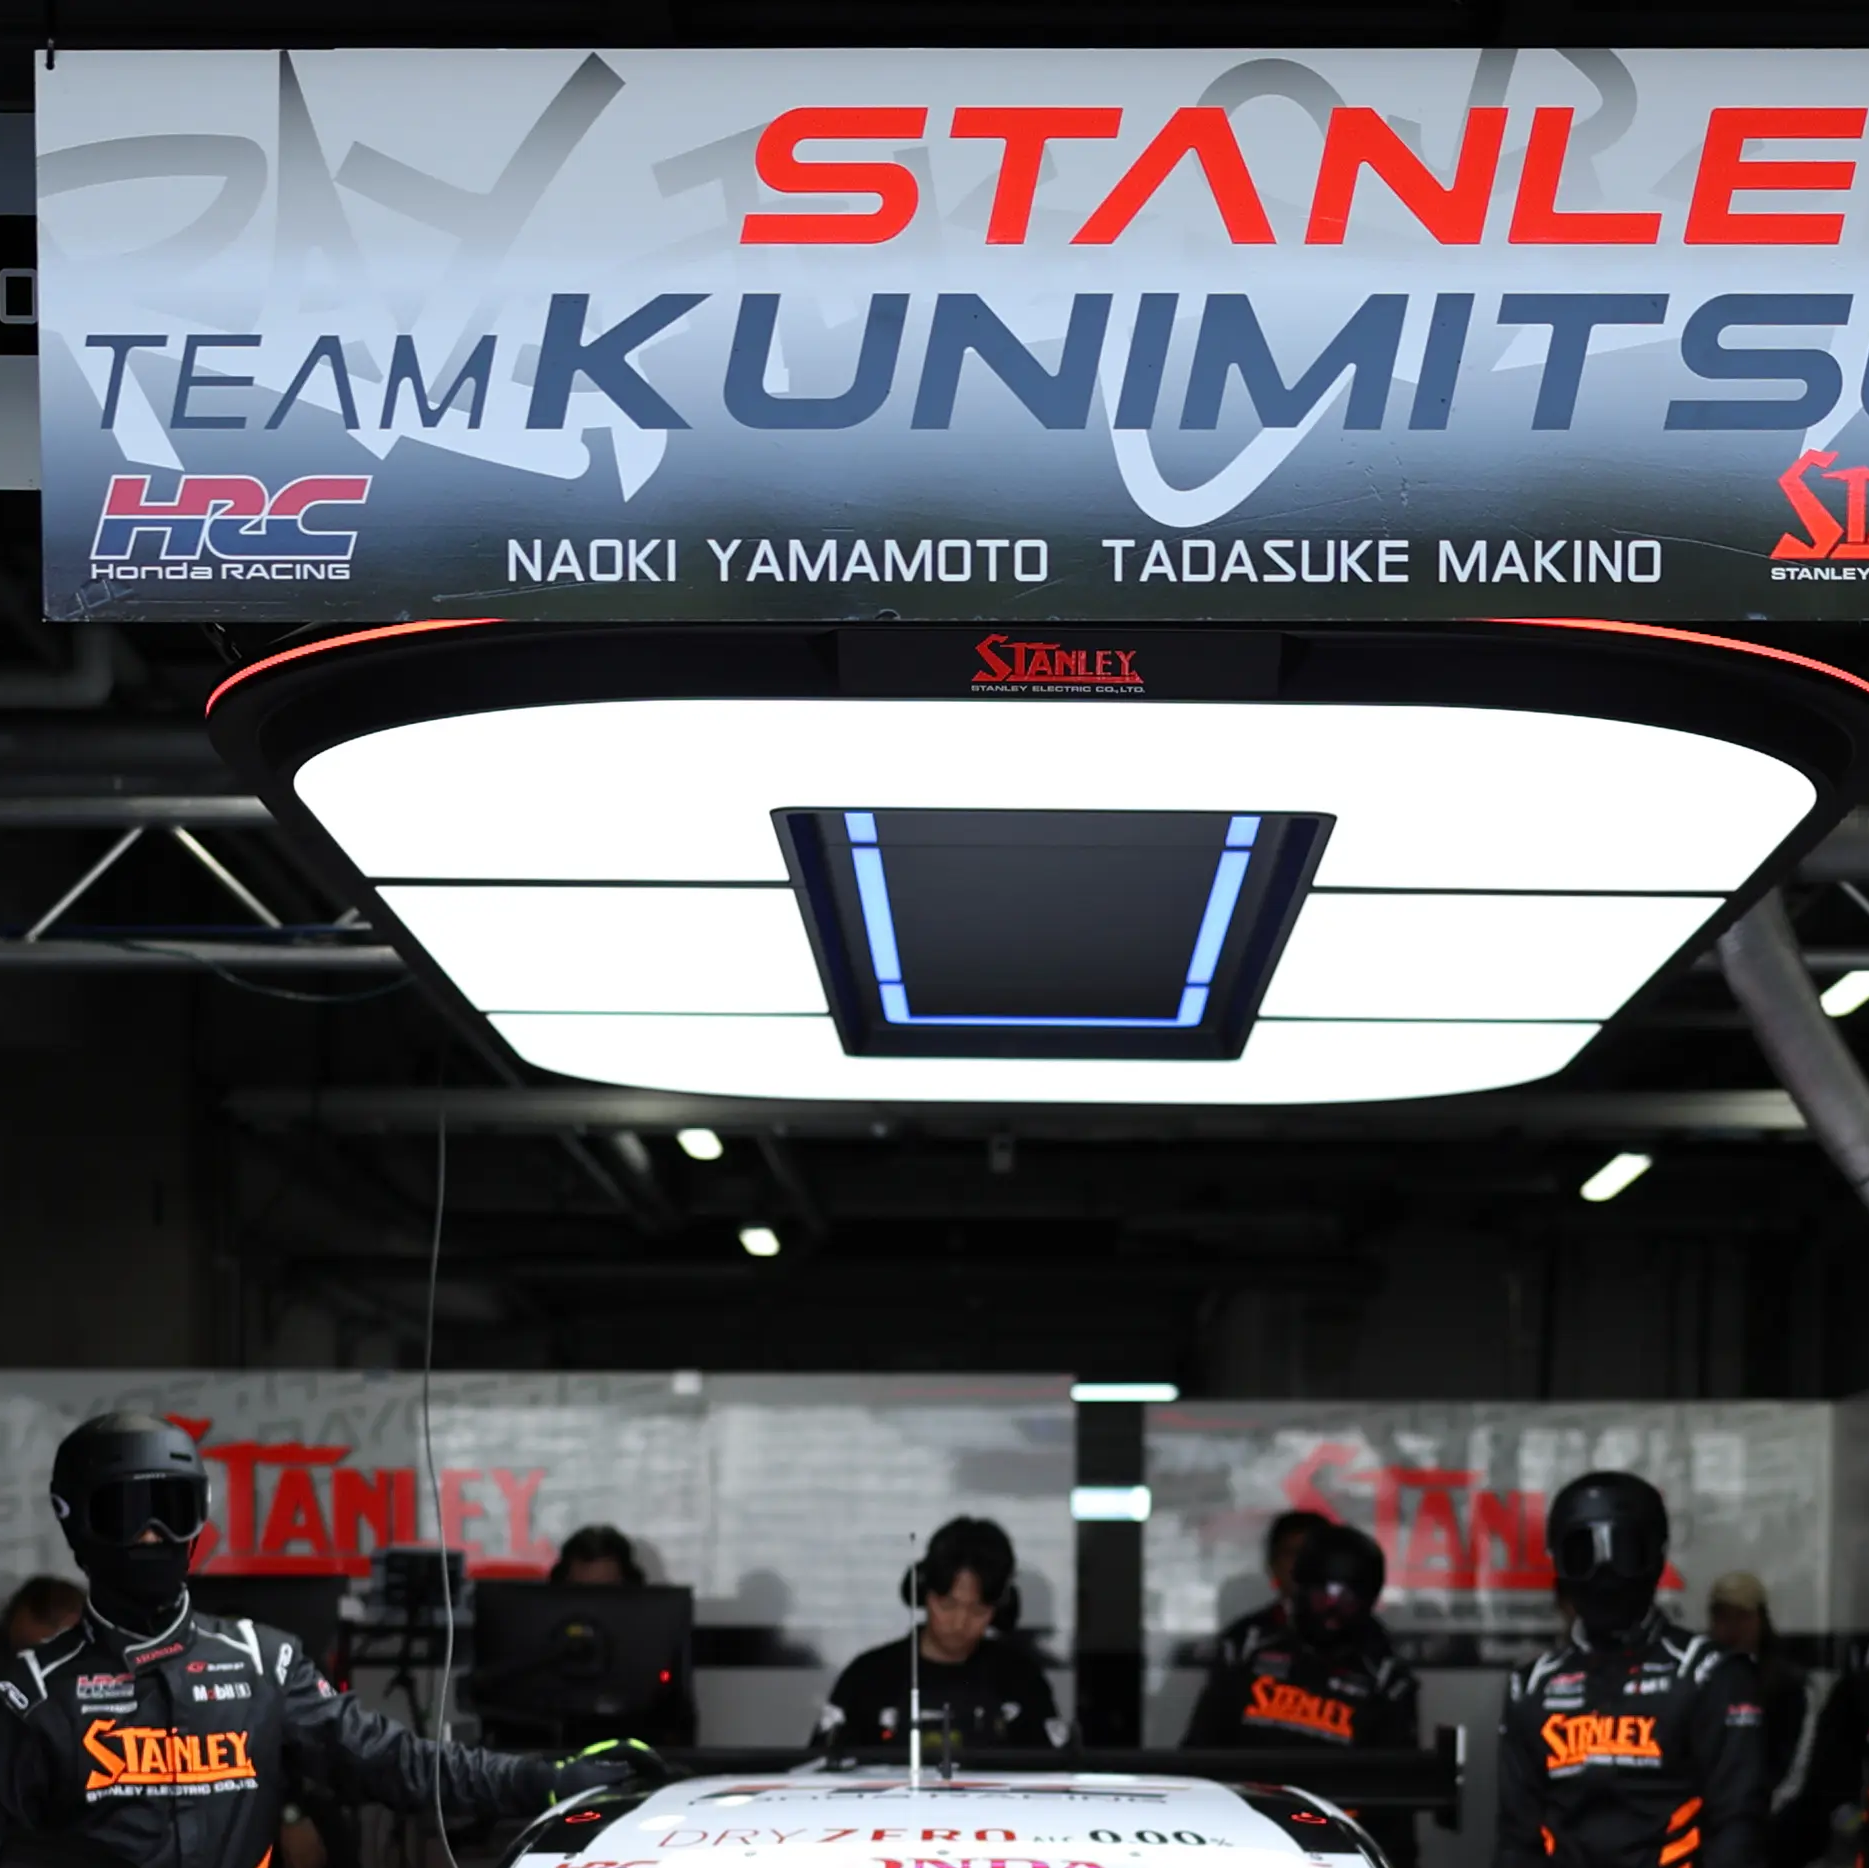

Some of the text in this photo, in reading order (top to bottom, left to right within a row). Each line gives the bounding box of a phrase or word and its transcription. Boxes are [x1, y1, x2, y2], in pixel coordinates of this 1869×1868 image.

[84, 334, 498, 431] TEAM
[89, 473, 374, 561] HRC
[90, 562, 352, 582] Honda RACING
[507, 538, 1662, 584] NAOKI YAMAMOTO TADASUKE MAKINO
[971, 633, 1145, 684] STANLEY
[970, 684, 1028, 693] STANLEY
[1032, 684, 1092, 693] ELECTRIC
[165, 1411, 559, 1579] TANLEY
[81, 1718, 257, 1791] STANLEY
[657, 1828, 808, 1848] DRY
[816, 1828, 1017, 1845] ZERO
